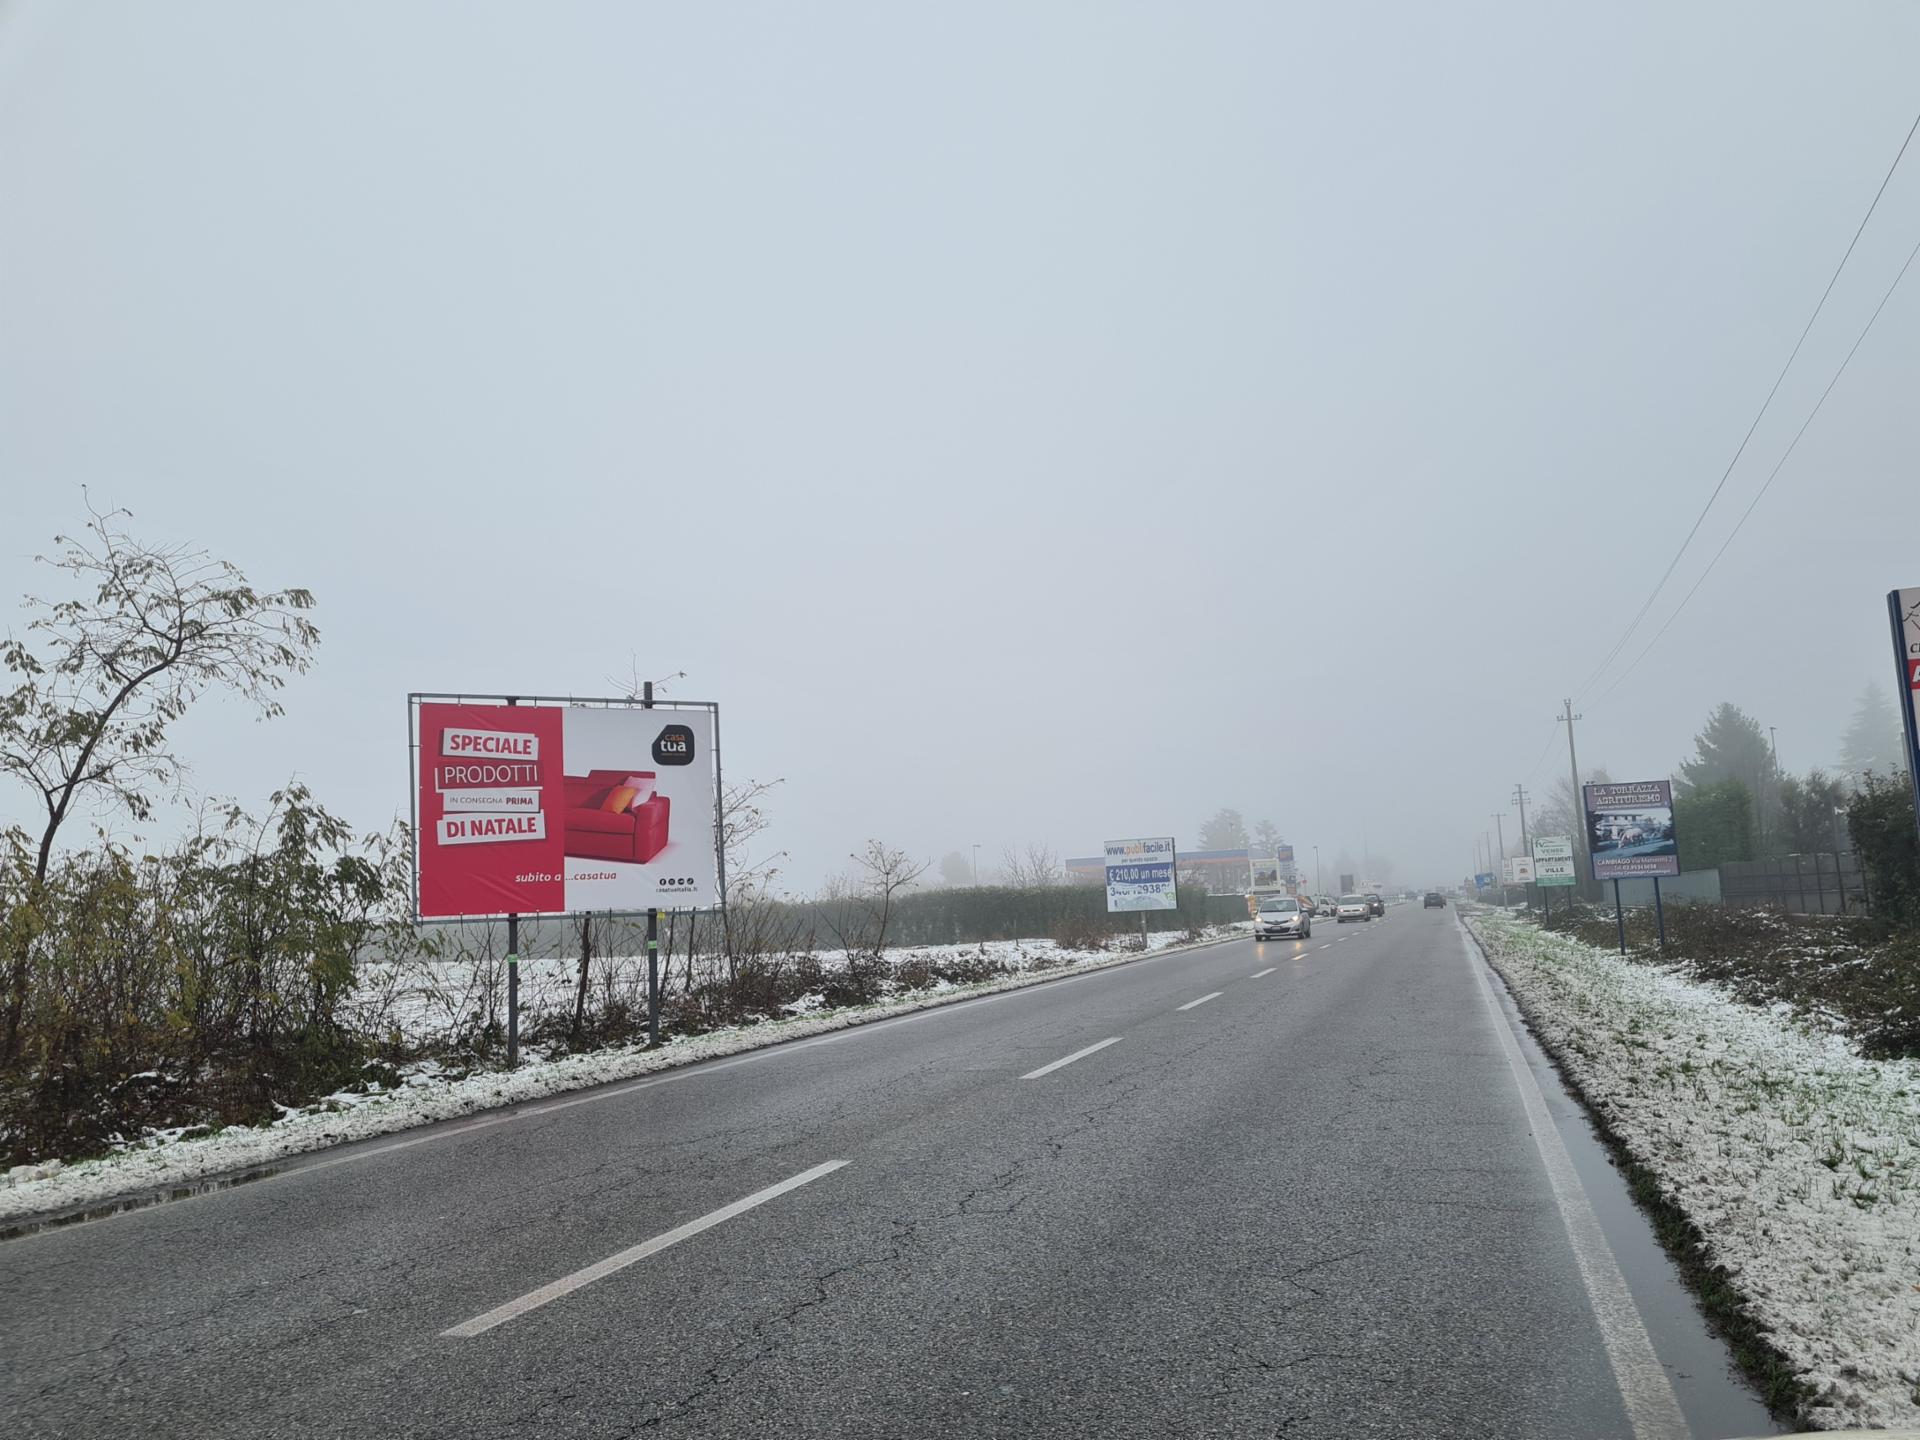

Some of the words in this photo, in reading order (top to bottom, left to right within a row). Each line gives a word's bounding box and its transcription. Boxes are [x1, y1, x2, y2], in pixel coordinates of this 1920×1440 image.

[450, 734, 532, 755] SPECIALE
[660, 739, 686, 751] tua
[444, 765, 538, 784] PRODOTTI
[1594, 787, 1606, 795] LA
[505, 797, 533, 805] PRIMA
[1596, 793, 1661, 804] AGRITURISMO
[446, 821, 465, 837] DI
[470, 817, 537, 836] NATALE
[515, 872, 551, 883] subito
[1116, 868, 1139, 881] 210,00
[1140, 869, 1150, 879] un
